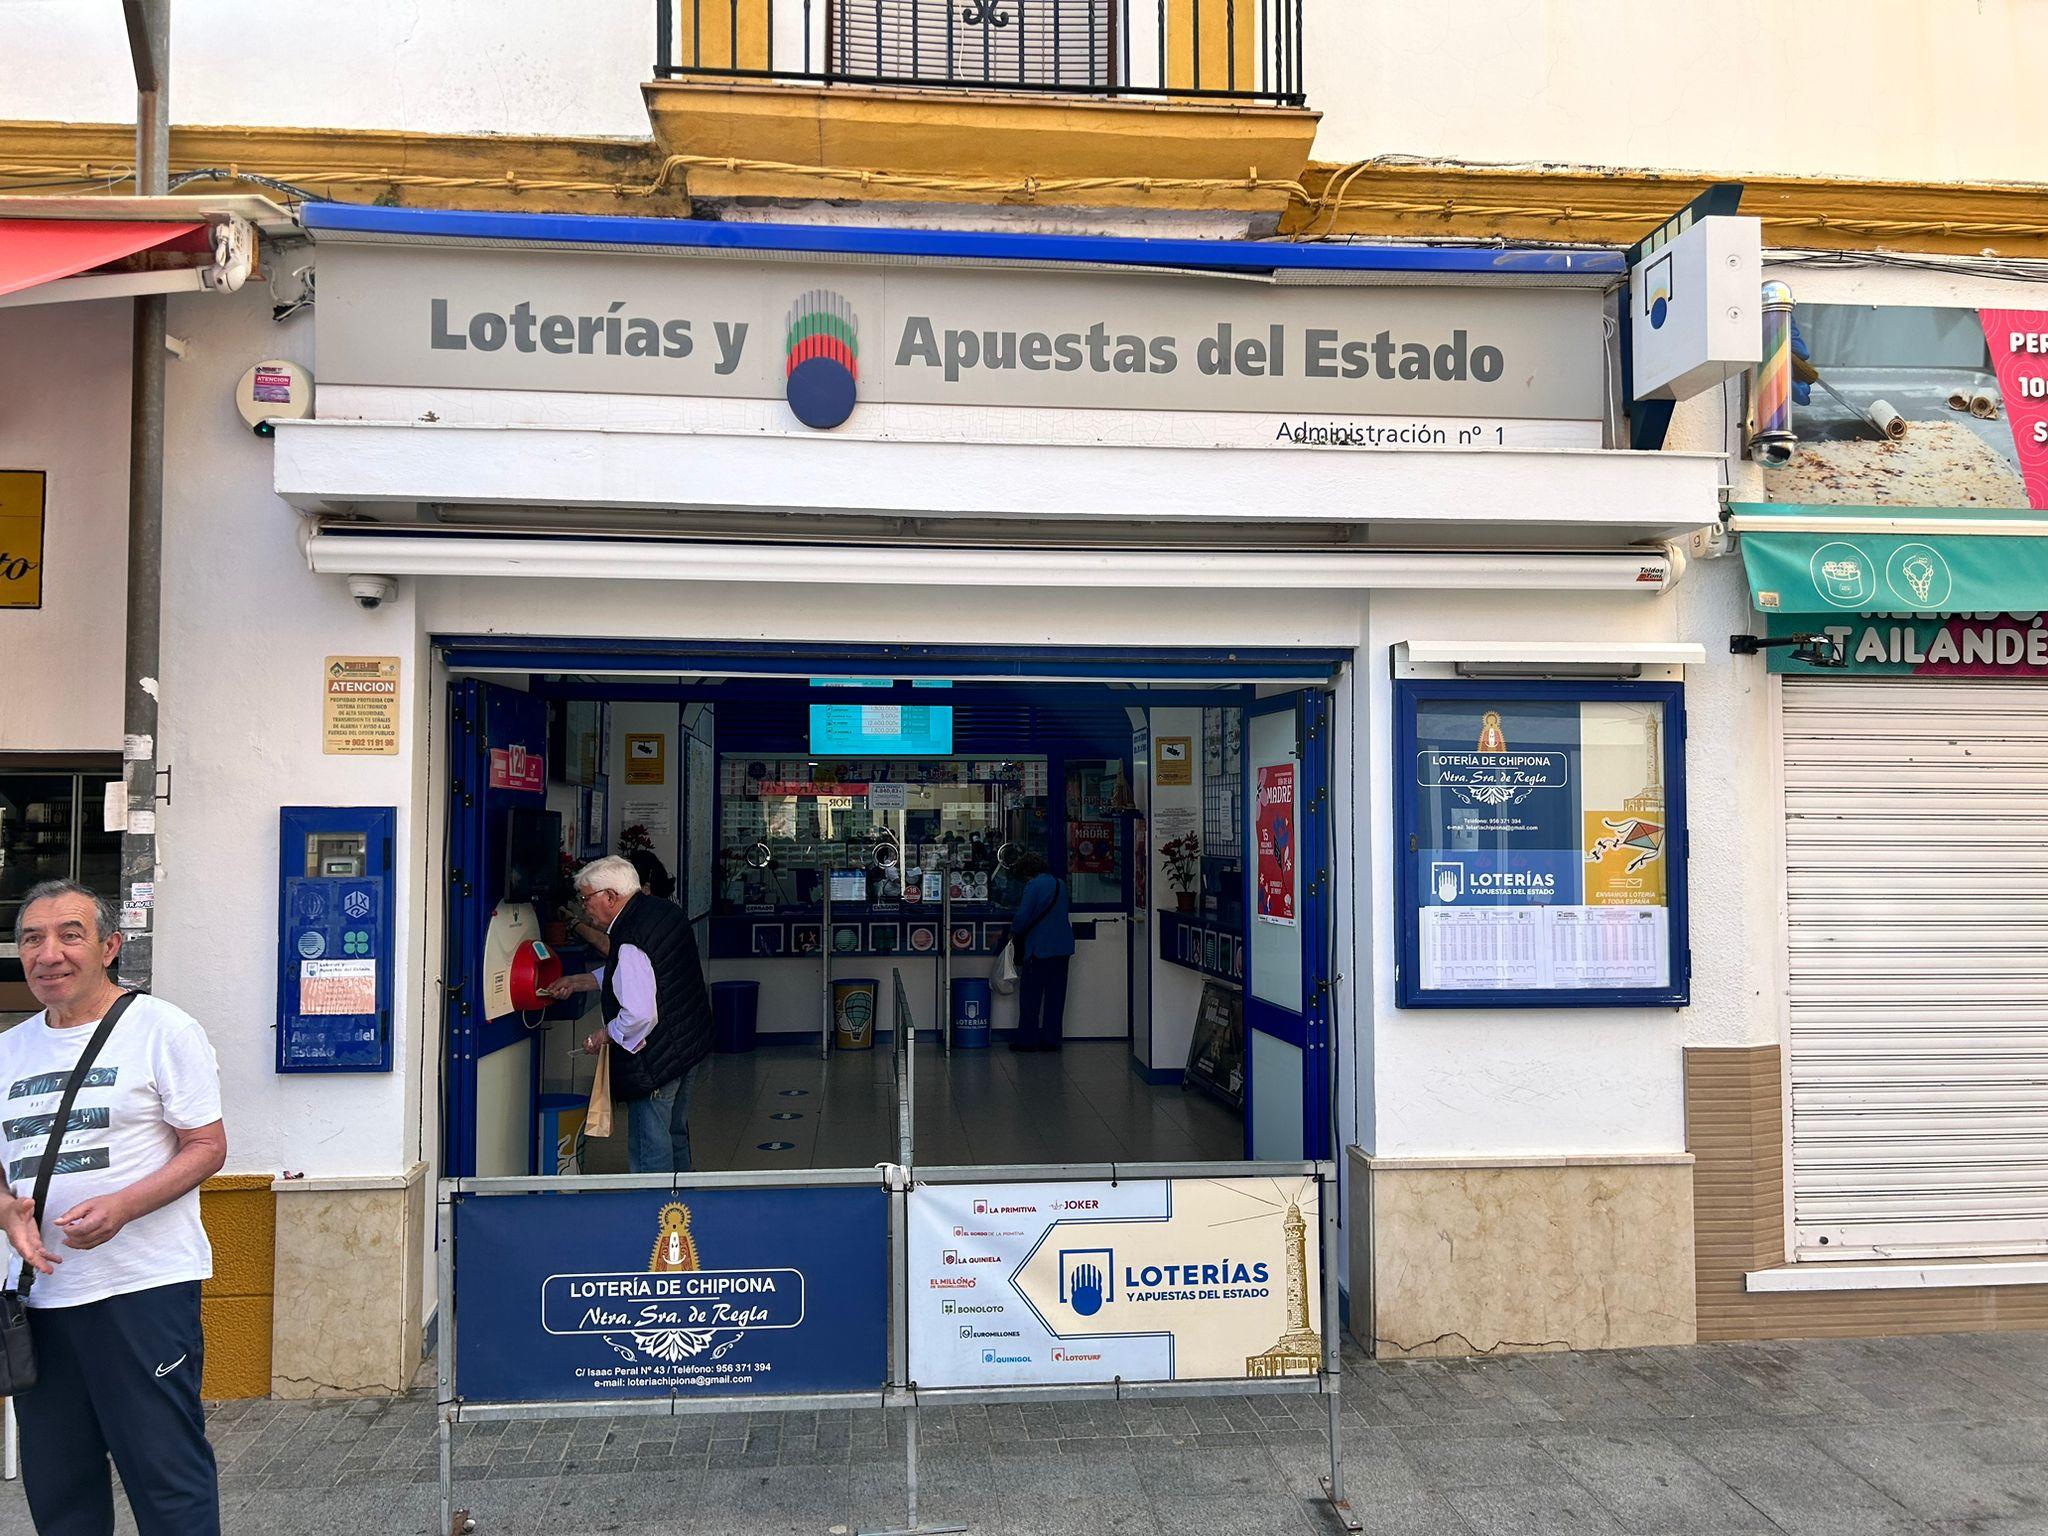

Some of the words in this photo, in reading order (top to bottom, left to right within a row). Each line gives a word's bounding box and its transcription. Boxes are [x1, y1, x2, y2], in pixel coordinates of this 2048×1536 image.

[430, 299, 692, 358] Loterías
[713, 322, 749, 375] y
[894, 316, 1178, 382] Apuestas
[1196, 323, 1284, 377] del
[1304, 329, 1505, 382] Estado
[1276, 421, 1446, 445] Administración
[1495, 426, 1504, 445] 1
[331, 681, 394, 692] ATENCION
[1432, 754, 1479, 766] LOTERÍA
[1481, 757, 1497, 766] DE
[1498, 756, 1551, 766] CHIPIONA
[1437, 771, 1468, 784] Ntra.
[1470, 771, 1497, 784] Sra.
[1500, 771, 1511, 783] de
[1513, 771, 1547, 786] Regla
[1267, 786, 1292, 804] MADRE
[1470, 870, 1555, 887] LOTERÍAS
[1064, 1200, 1099, 1210] JOKER
[1125, 1259, 1269, 1287] LOTERÍAS
[571, 1276, 651, 1298] LOTERÍA
[656, 1279, 681, 1296] DE
[686, 1277, 776, 1295] CHIPIONA
[1126, 1292, 1136, 1302] Y
[1136, 1290, 1196, 1301] APUESTAS
[1198, 1290, 1220, 1300] DEL
[1222, 1288, 1269, 1299] ESTADO
[578, 1306, 632, 1330] Ntra.
[634, 1304, 682, 1327] Sra.
[688, 1305, 707, 1323] de
[711, 1303, 768, 1327] Regla
[958, 1306, 1004, 1314] BONOLOTO
[1065, 1354, 1101, 1362] LOTOTURF
[575, 1367, 586, 1376] C/
[587, 1366, 613, 1376] Isaac
[614, 1366, 639, 1375] Peral
[653, 1366, 665, 1375] 43
[672, 1364, 714, 1375] Teléfono:
[716, 1364, 733, 1373] 956
[735, 1364, 751, 1372] 371
[754, 1363, 771, 1372] 394
[594, 1377, 625, 1388] e-mail:
[627, 1375, 753, 1388] loteriachipiona@gmail.com
